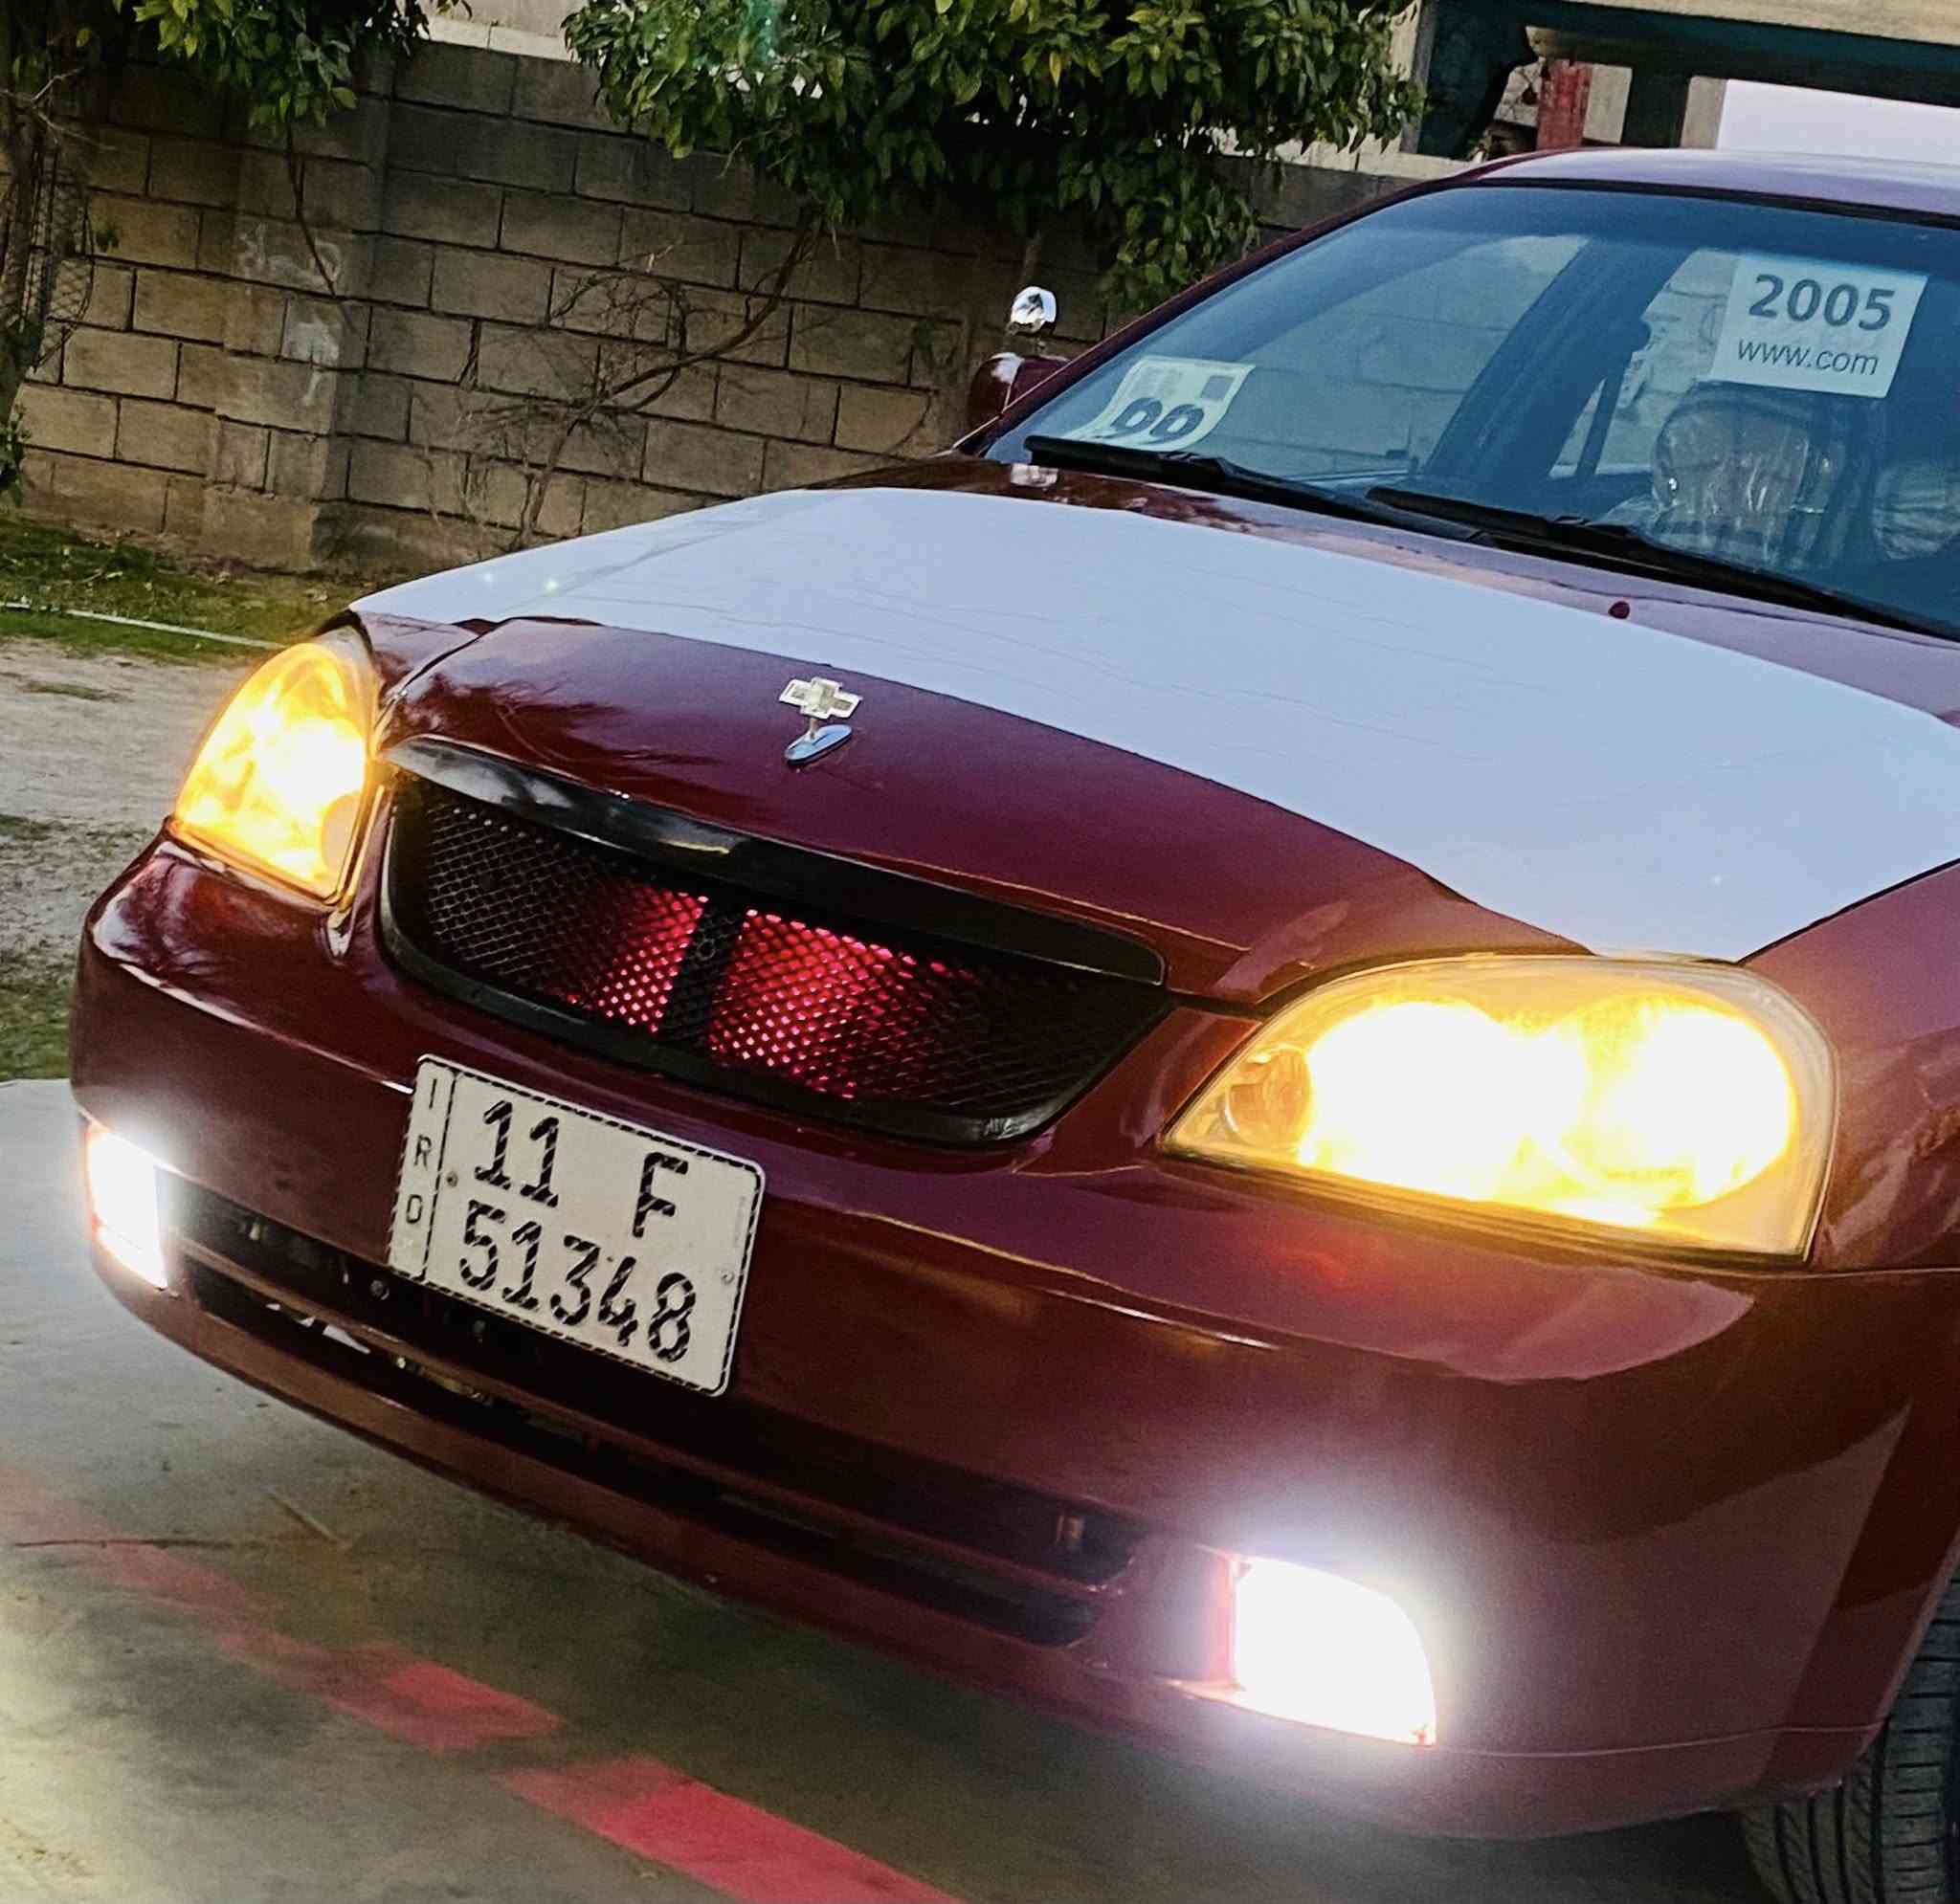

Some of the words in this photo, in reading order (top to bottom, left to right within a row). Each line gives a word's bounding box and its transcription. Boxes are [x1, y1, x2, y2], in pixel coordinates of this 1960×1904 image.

[1748, 274, 1895, 331] 2005
[1738, 339, 1879, 375] www.com
[475, 1100, 559, 1207] 11
[633, 1151, 689, 1238] F
[458, 1199, 696, 1363] 51348
